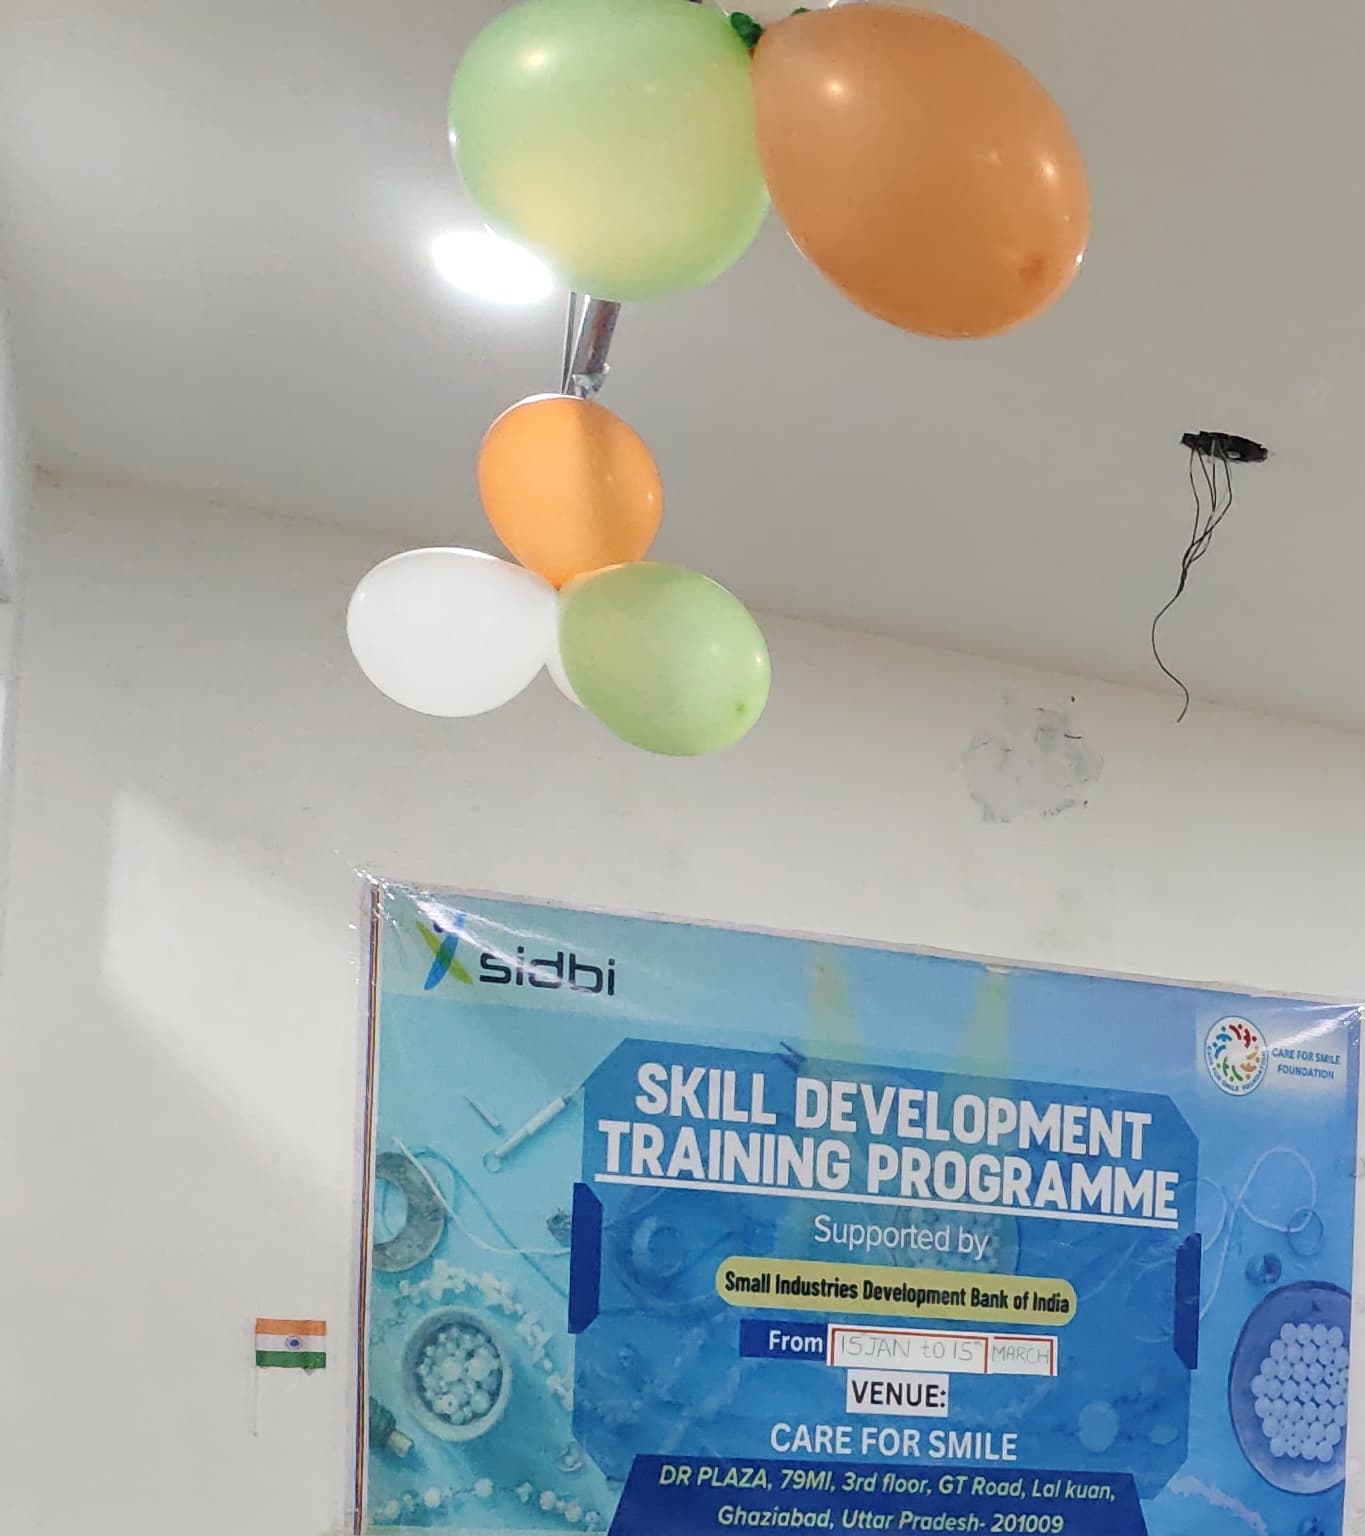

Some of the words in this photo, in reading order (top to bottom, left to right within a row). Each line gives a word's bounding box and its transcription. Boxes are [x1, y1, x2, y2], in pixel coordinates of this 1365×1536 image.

[480, 946, 616, 996] sidbi
[1271, 1048, 1295, 1060] CARE
[1297, 1050, 1314, 1062] FOR
[1315, 1052, 1341, 1065] SMILE
[1277, 1063, 1335, 1080] FOUNDATION
[635, 1062, 777, 1125] SKILL
[795, 1076, 1153, 1160] DEVELOPMENT
[598, 1119, 851, 1191] TRAINING
[866, 1143, 1179, 1219] PROGRAMME
[814, 1214, 950, 1252] Supported
[958, 1226, 990, 1261] by
[725, 1270, 771, 1295] Small
[776, 1274, 858, 1300] Industries
[863, 1279, 967, 1309] Development
[971, 1287, 1009, 1310] Bank
[1013, 1293, 1029, 1311] of
[1032, 1291, 1070, 1314] India
[769, 1329, 823, 1354] From
[991, 1344, 1049, 1365] MARCH
[852, 1380, 946, 1408] VENUE:
[770, 1422, 853, 1455] CARE
[861, 1427, 921, 1457] FOR
[928, 1429, 1018, 1461] SMILE
[659, 1464, 692, 1486] DR
[697, 1466, 773, 1491] PLAZA,
[780, 1468, 836, 1492] 79MI,
[841, 1472, 878, 1492] 3rd
[882, 1472, 932, 1495] floor,
[938, 1475, 968, 1495] GT
[971, 1476, 1026, 1500] Road,
[1031, 1479, 1060, 1499] Lal
[1065, 1480, 1116, 1502] kuan,
[717, 1504, 835, 1530] Ghaziabad,
[841, 1508, 894, 1530] Uttar
[899, 1510, 986, 1532] Pradesh-
[990, 1513, 1065, 1534] 201009
